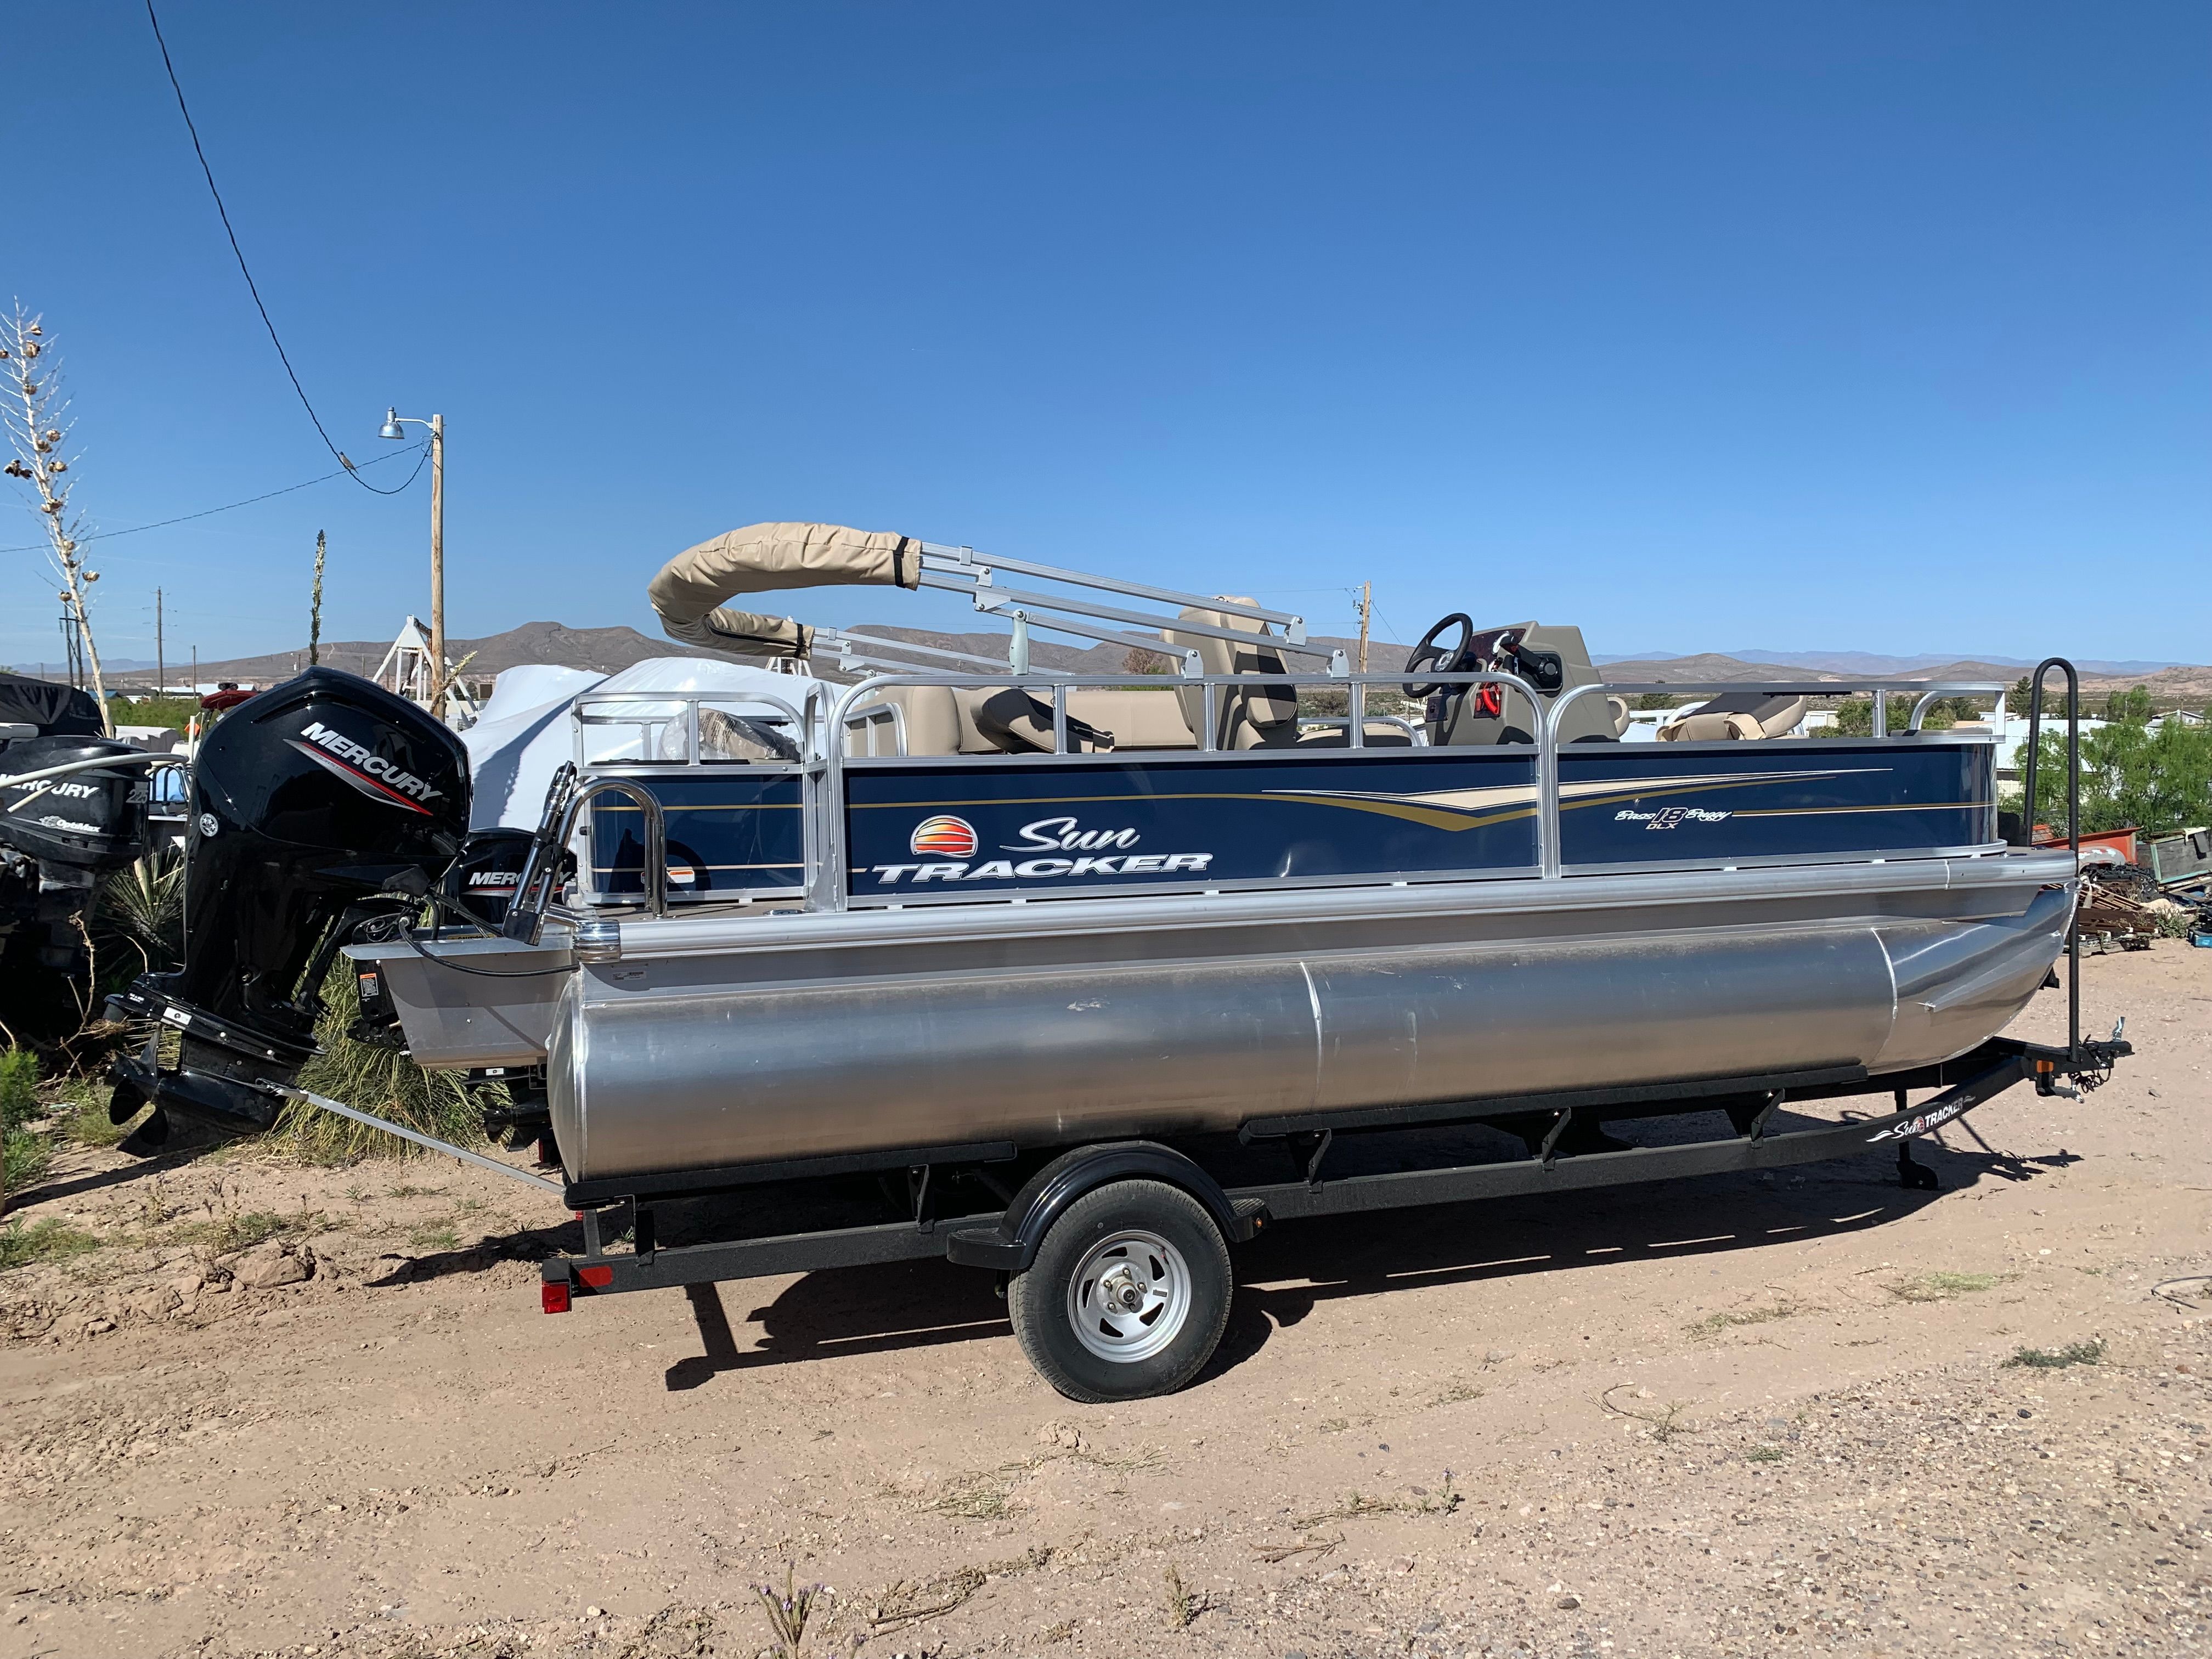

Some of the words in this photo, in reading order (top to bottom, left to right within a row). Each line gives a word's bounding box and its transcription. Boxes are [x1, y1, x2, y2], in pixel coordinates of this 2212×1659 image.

[301, 721, 443, 802] MERCURY
[126, 788, 149, 804] 225
[57, 819, 101, 832] OptiMax
[1615, 810, 1656, 820] Bass
[1651, 807, 1688, 823] 18
[1685, 809, 1732, 822] Buggy
[1000, 817, 1141, 852] Sun
[872, 853, 1214, 884] TRACKER
[1891, 1121, 1922, 1139] Sun
[1925, 1097, 1963, 1128] TRACKER
